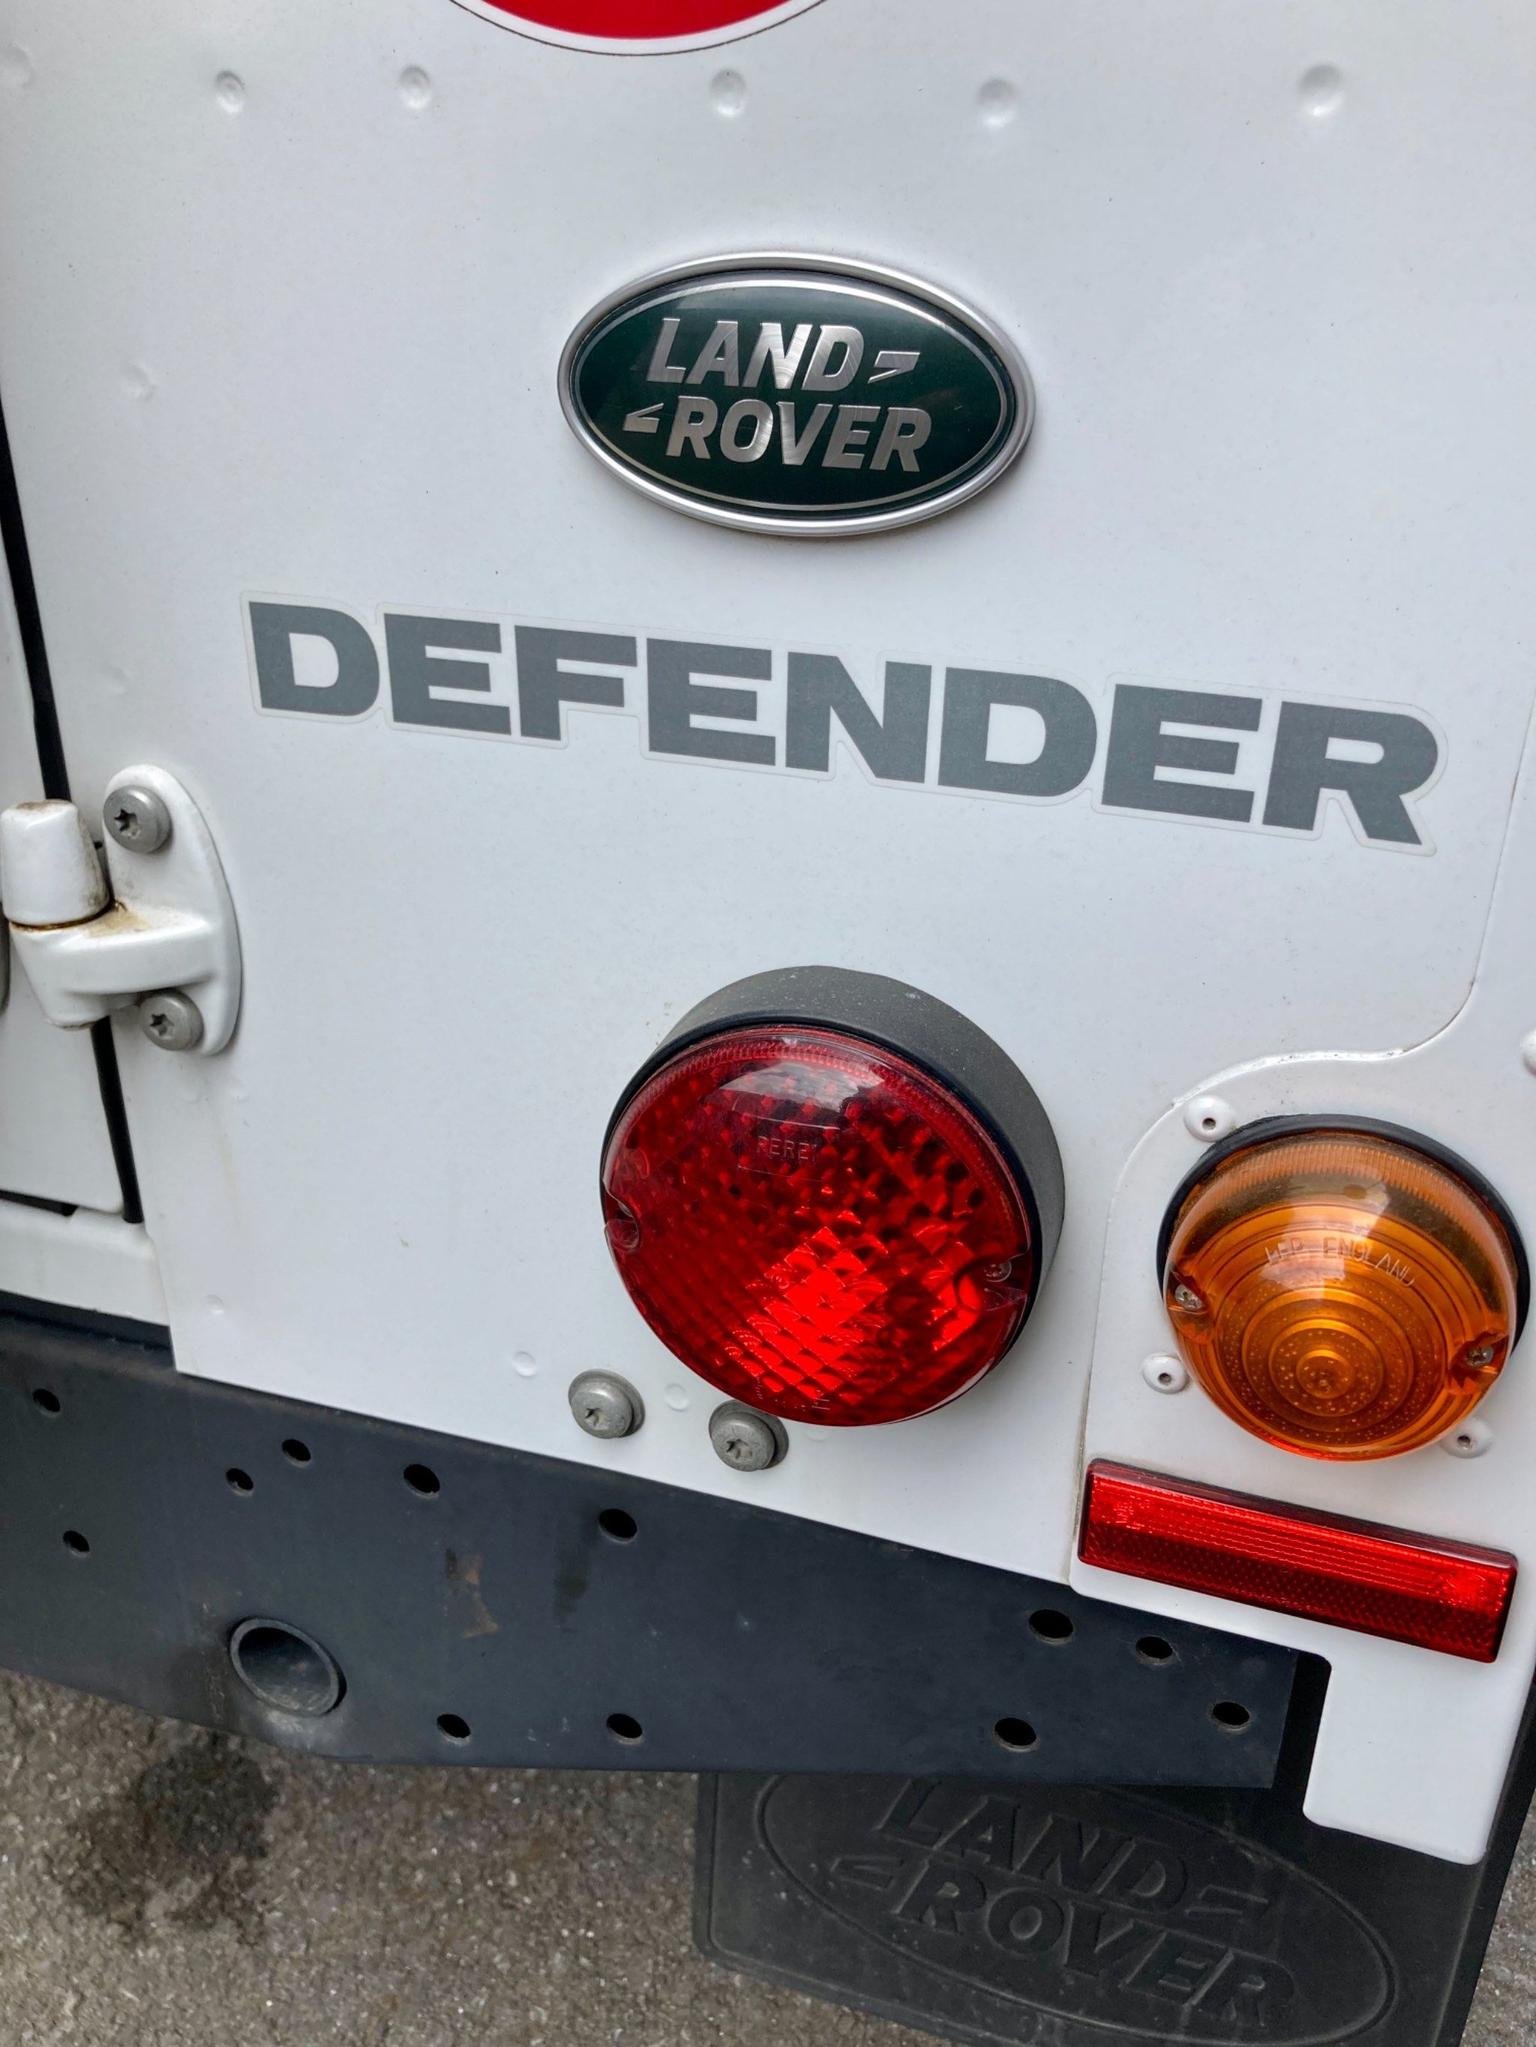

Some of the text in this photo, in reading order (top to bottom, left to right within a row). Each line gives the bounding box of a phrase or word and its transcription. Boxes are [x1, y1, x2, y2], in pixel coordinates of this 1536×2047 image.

[646, 318, 865, 392] LAND
[666, 395, 932, 472] ROVER
[248, 599, 1440, 846] DEFENDER
[1323, 1236, 1416, 1287] ENGLAND
[873, 1778, 1189, 1913] LAND
[891, 1858, 1298, 2028] ROVER
